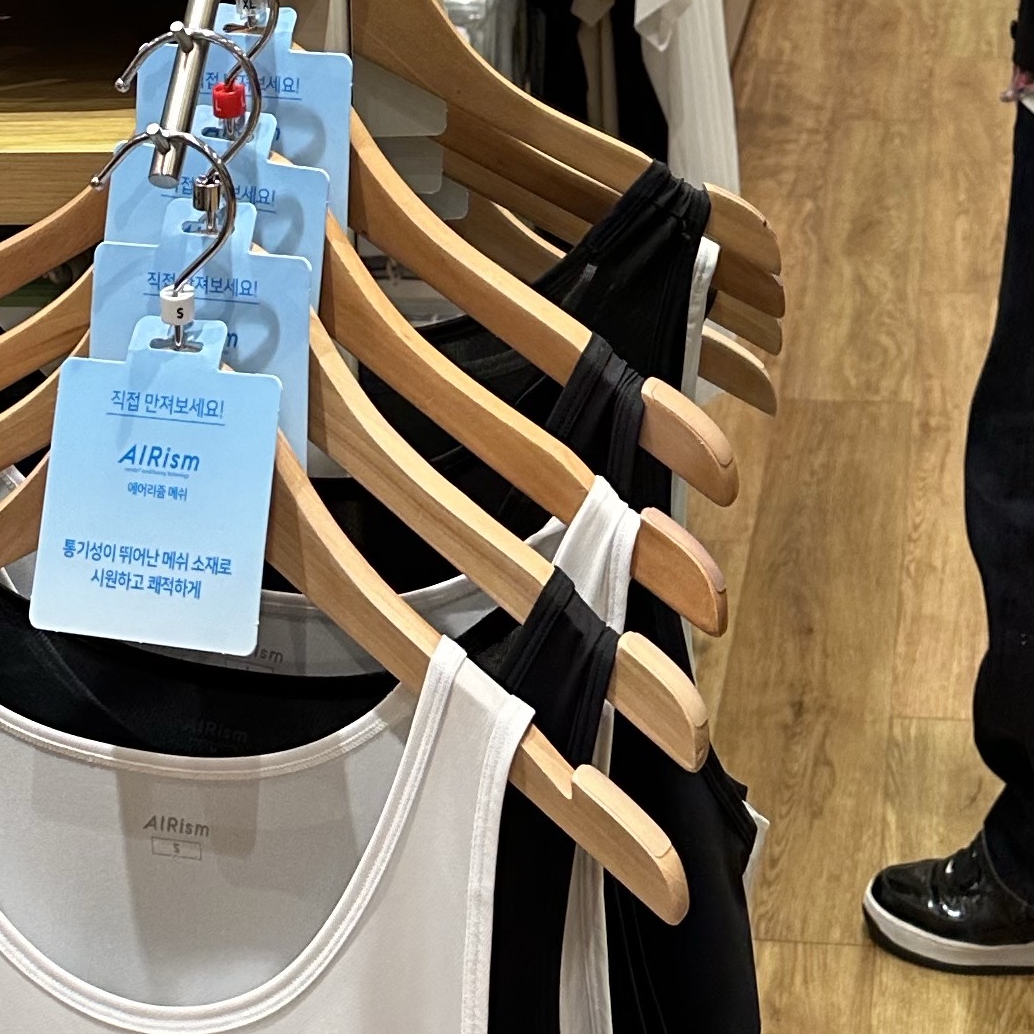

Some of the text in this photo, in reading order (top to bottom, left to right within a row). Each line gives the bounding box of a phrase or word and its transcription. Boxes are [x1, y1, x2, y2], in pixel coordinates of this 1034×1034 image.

[242, 0, 257, 9] XL
[176, 307, 184, 319] S
[111, 390, 225, 419] 직접 만져보세요!
[117, 444, 201, 472] AIRism
[127, 481, 188, 502] 에어리즘 메쉬
[62, 538, 232, 576] 통기성이 뛰어난 메쉬 소재로
[90, 568, 202, 599] 시원하고 쾌적하게
[142, 814, 210, 838] AIRism
